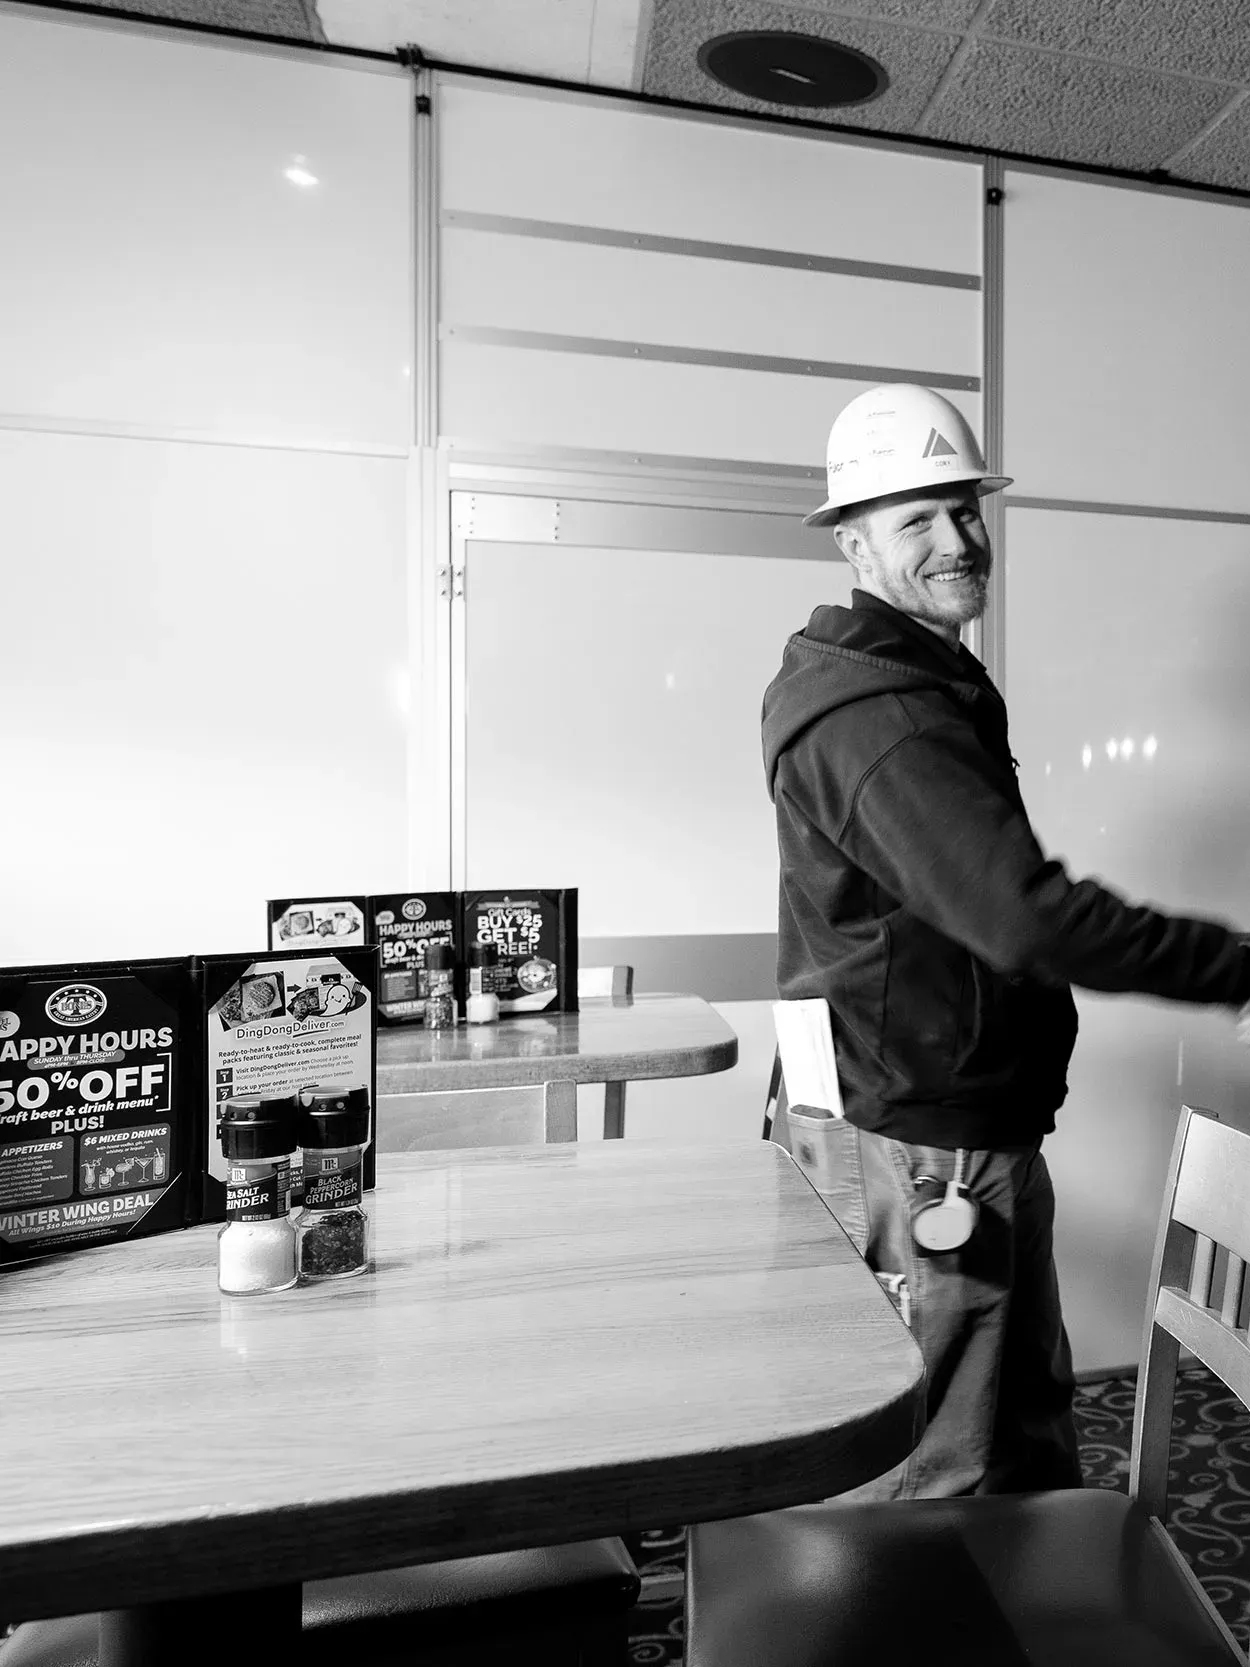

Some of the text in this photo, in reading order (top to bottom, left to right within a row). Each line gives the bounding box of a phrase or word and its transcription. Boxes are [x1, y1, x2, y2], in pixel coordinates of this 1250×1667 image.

[379, 922, 415, 936] HAPPY
[416, 919, 452, 932] HOURS
[477, 913, 543, 929] BUY $25
[477, 926, 540, 944] GET $5
[236, 1020, 344, 1039] DingDongDeliver.com
[0, 1027, 173, 1062] APPY HOURS
[218, 1046, 265, 1058] Ready-to-heat
[317, 1036, 346, 1046] complete
[34, 1055, 64, 1065] SUNDAY
[80, 1051, 117, 1060] THURSDAY
[222, 1055, 242, 1065] packs
[243, 1051, 274, 1063] featuring
[274, 1049, 296, 1057] classic
[302, 1045, 329, 1054] seasonal
[236, 1065, 249, 1074] Visit
[250, 1059, 310, 1072] DingDongDeliver.com
[222, 1074, 226, 1082] 1
[236, 1083, 248, 1091] Pick
[249, 1083, 258, 1091] up
[258, 1081, 272, 1090] your
[221, 1092, 228, 1100] 2
[0, 1111, 28, 1125] raft
[30, 1107, 62, 1121] beer
[65, 1105, 75, 1116] &
[78, 1100, 114, 1115] drink
[51, 1115, 105, 1134] PLUS!
[84, 1127, 167, 1146] $6 MIXED DRINKS
[1, 1141, 63, 1157] APPETIZERS
[310, 1178, 354, 1194] PEPPERCORN
[318, 1175, 342, 1187] BLACK
[237, 1187, 259, 1198] SALT
[305, 1182, 358, 1204] GRINDER
[63, 1200, 110, 1220] WING
[113, 1193, 154, 1211] DEAL
[226, 1193, 269, 1210] RINDER
[8, 1228, 20, 1236] All
[21, 1225, 45, 1236] Wings
[61, 1217, 87, 1228] During
[88, 1214, 111, 1225] Happy
[112, 1209, 137, 1219] Hours!
